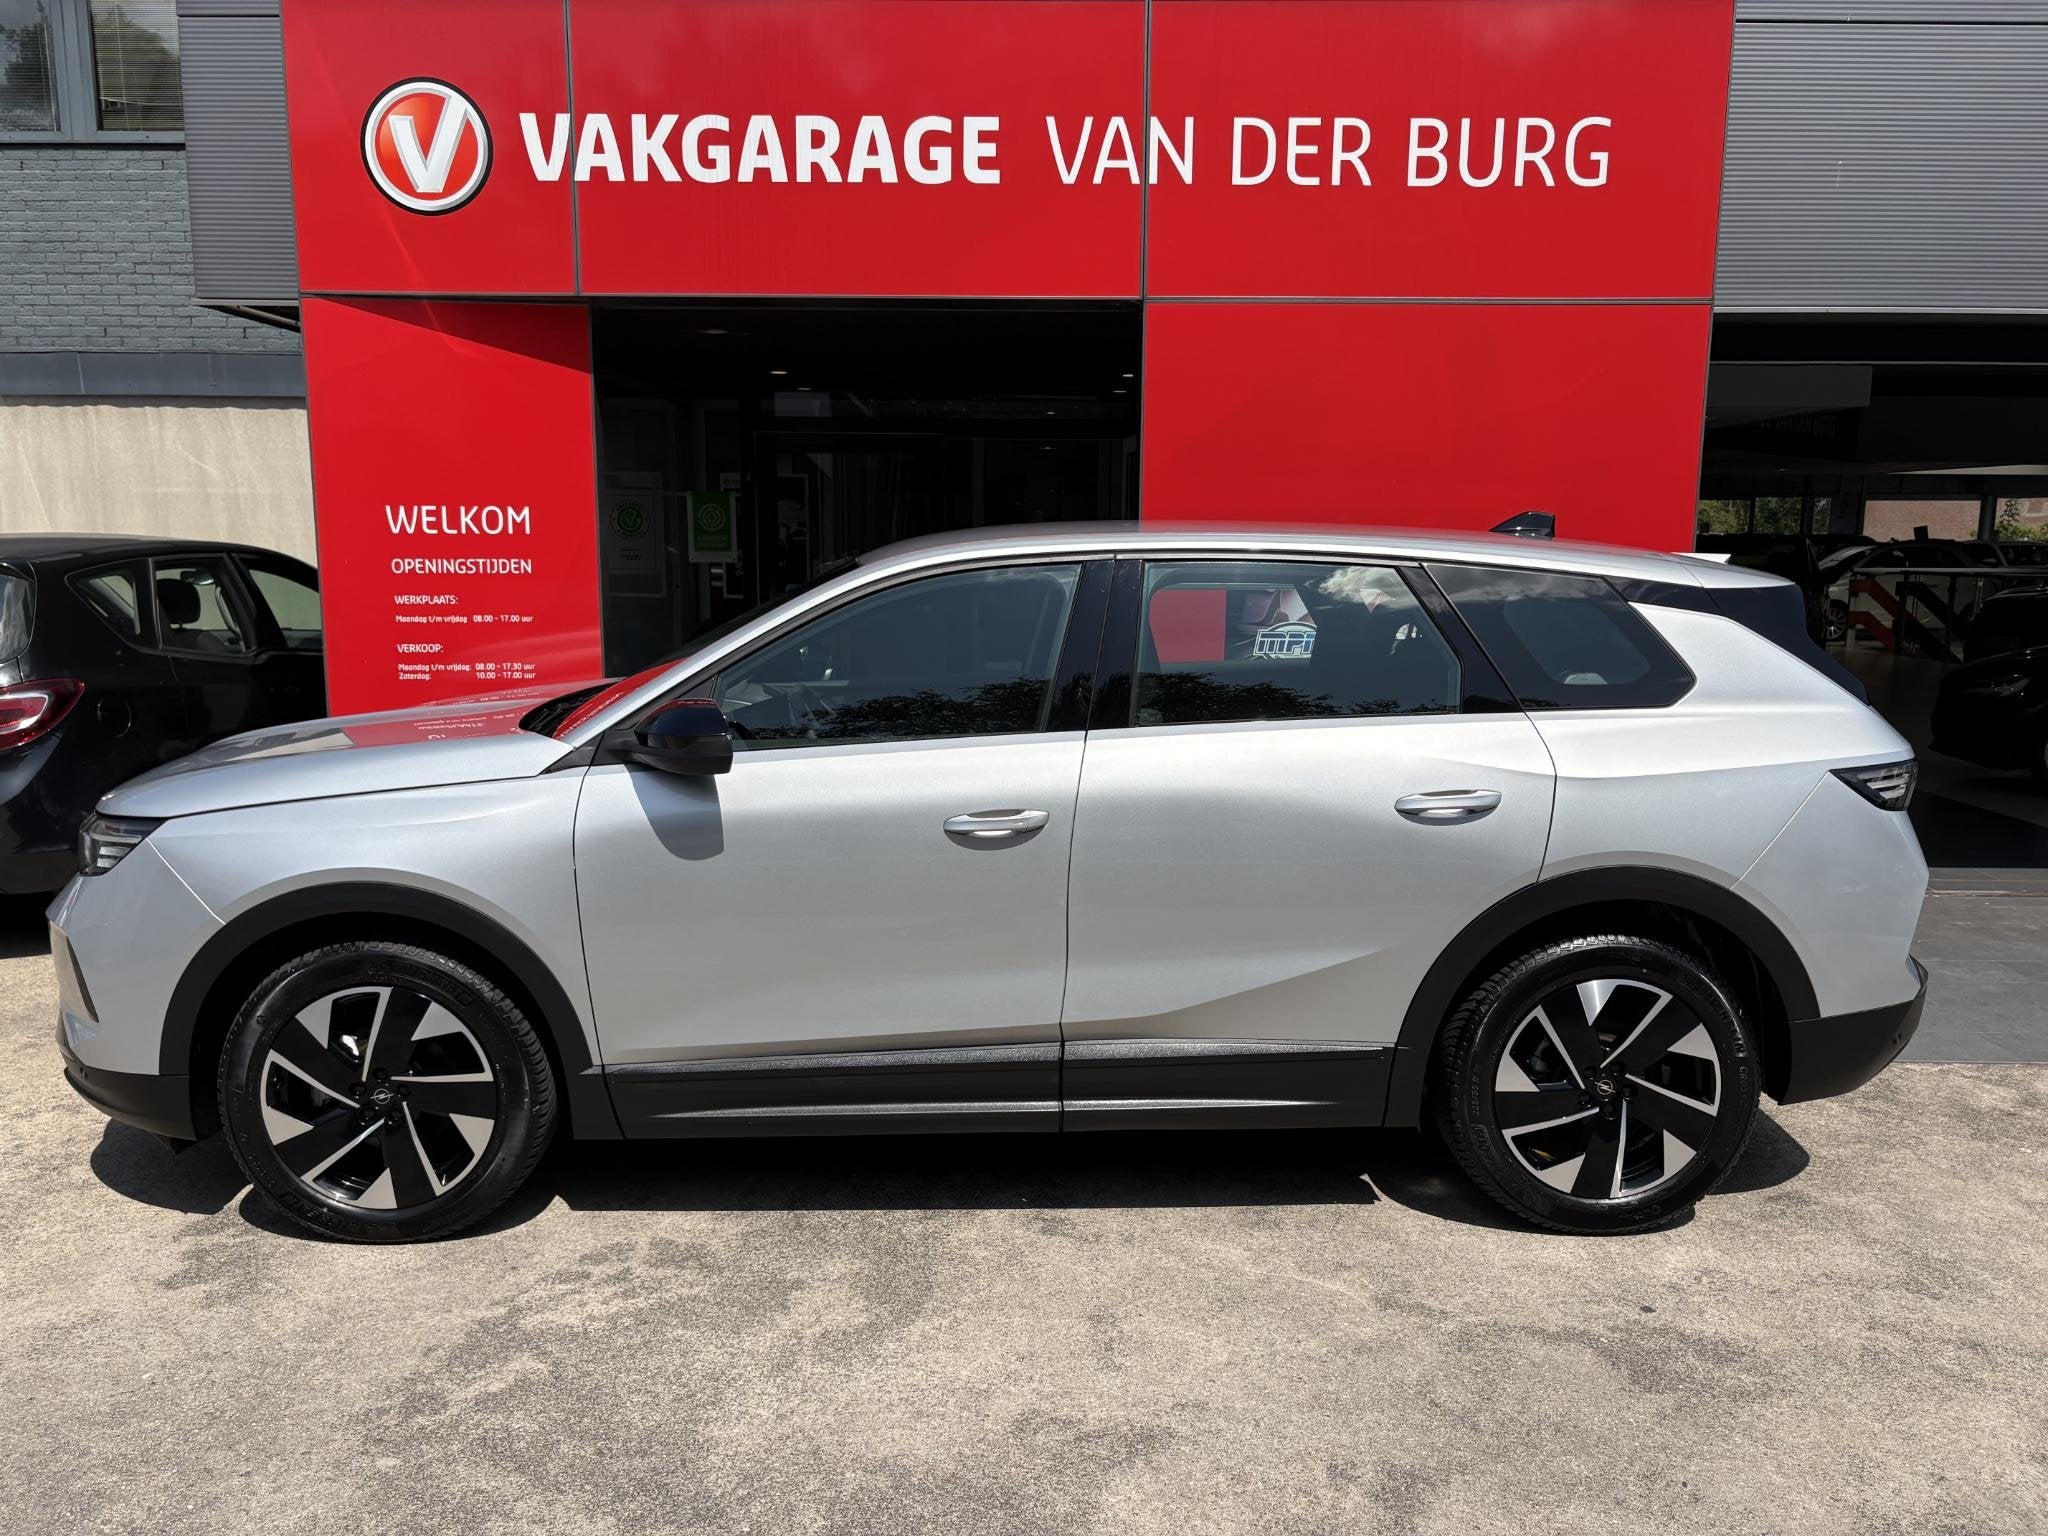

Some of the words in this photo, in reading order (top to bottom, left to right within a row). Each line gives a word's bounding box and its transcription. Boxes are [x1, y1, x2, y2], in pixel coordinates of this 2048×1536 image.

[519, 112, 1000, 184] VAKGARAGE
[1046, 115, 1194, 185] VAN
[1232, 116, 1371, 186] DER
[1407, 116, 1612, 187] BURG
[385, 504, 531, 535] WELKOM
[391, 558, 532, 575] OPENINGSTIJDEN
[394, 595, 459, 605] WERKPLAATS:
[395, 615, 427, 624] Maandag
[428, 615, 443, 623] t/m
[444, 615, 468, 624] vrijdag
[473, 614, 493, 623] 08.00
[500, 614, 520, 622] 17.00
[397, 643, 444, 654] VERKOOP:
[398, 663, 430, 672] Maandag
[431, 663, 445, 671] t/m
[475, 662, 496, 671] 08.00
[523, 663, 536, 671] uur
[475, 671, 496, 680] 10.00
[502, 671, 522, 680] 17.00
[523, 672, 536, 680] uur
